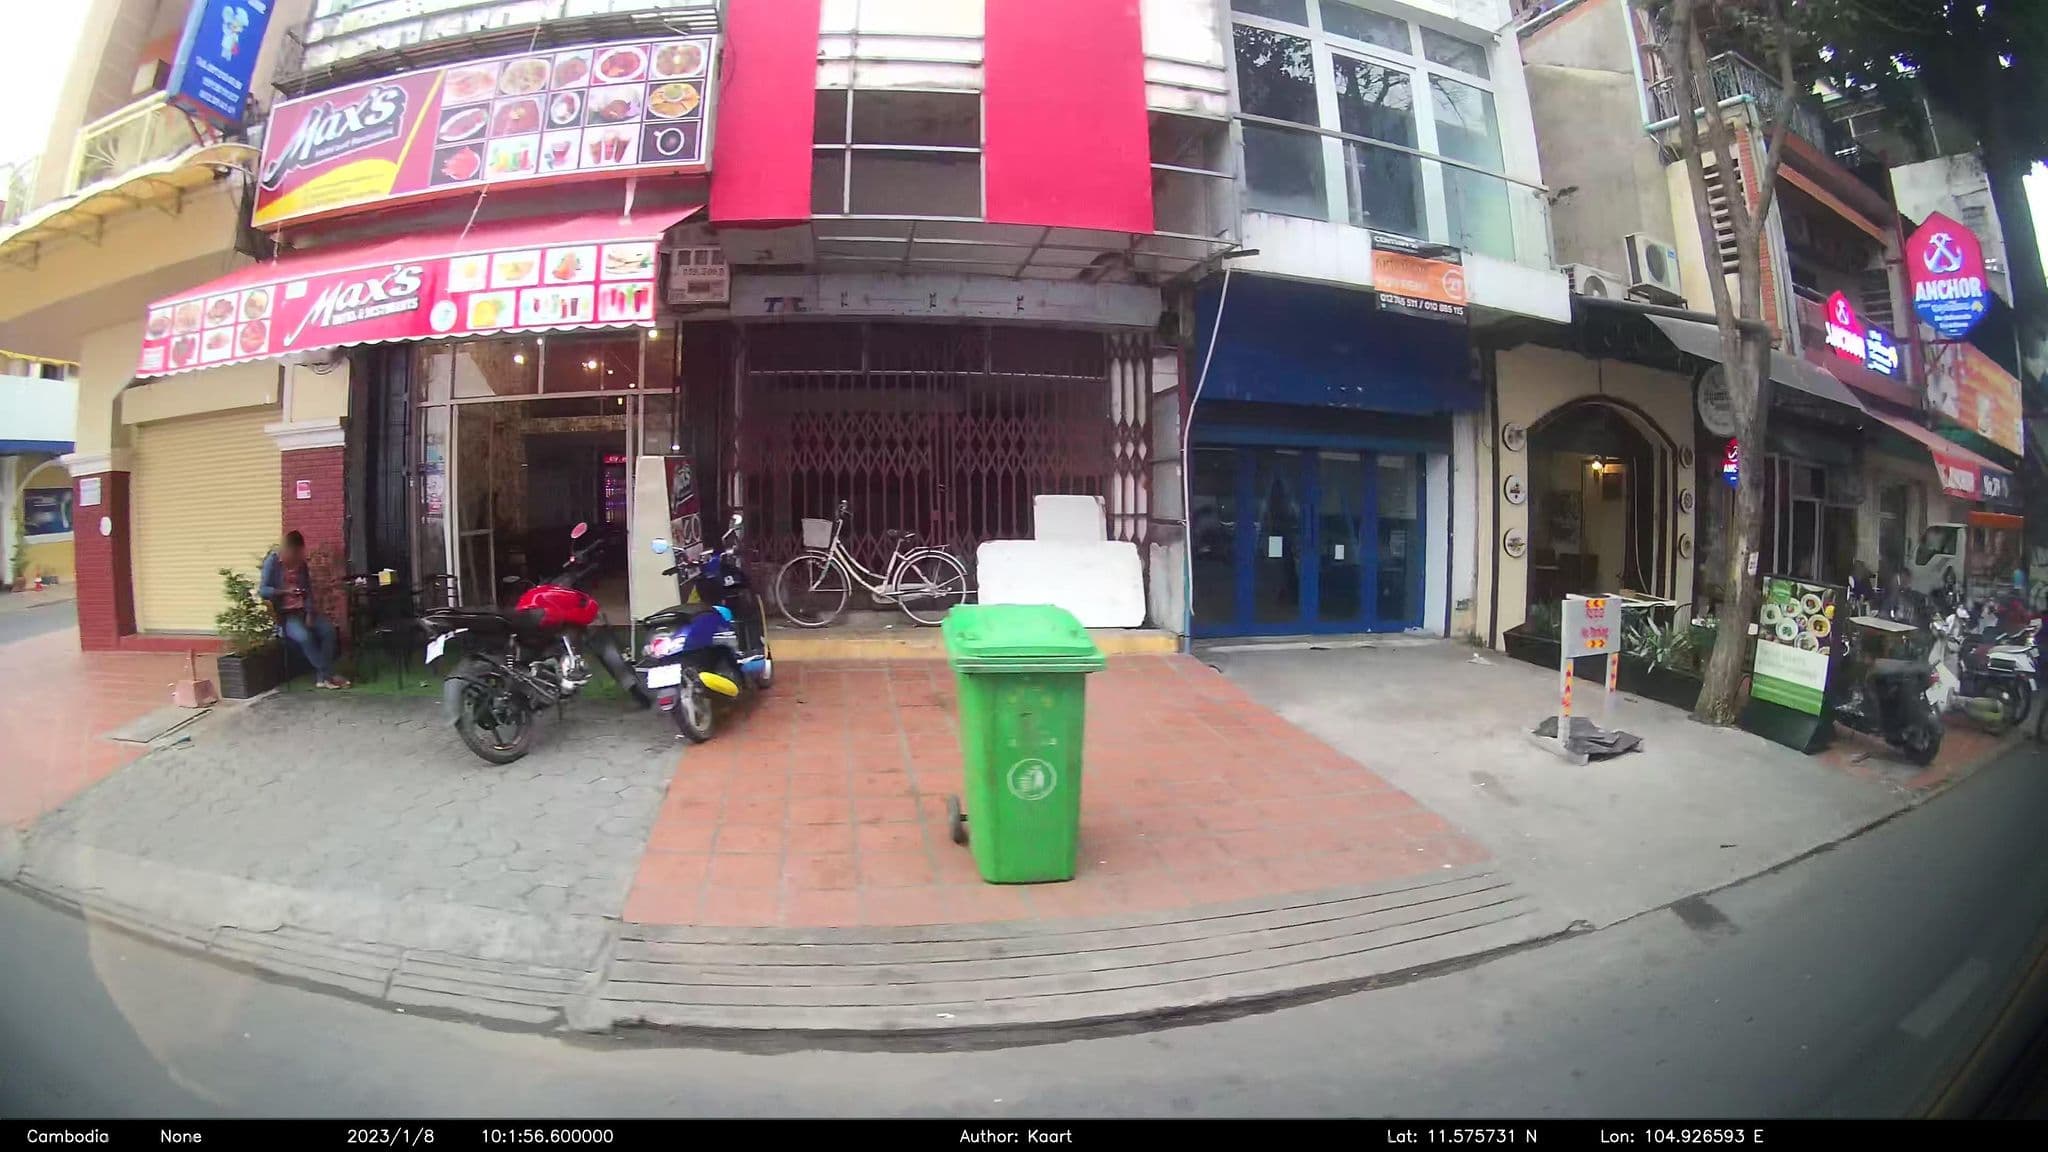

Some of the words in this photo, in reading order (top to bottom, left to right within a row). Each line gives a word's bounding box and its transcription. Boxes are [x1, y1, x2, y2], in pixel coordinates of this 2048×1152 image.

[262, 86, 401, 183] Max's
[283, 265, 423, 347] Max's
[1915, 276, 1983, 302] ANCHOR
